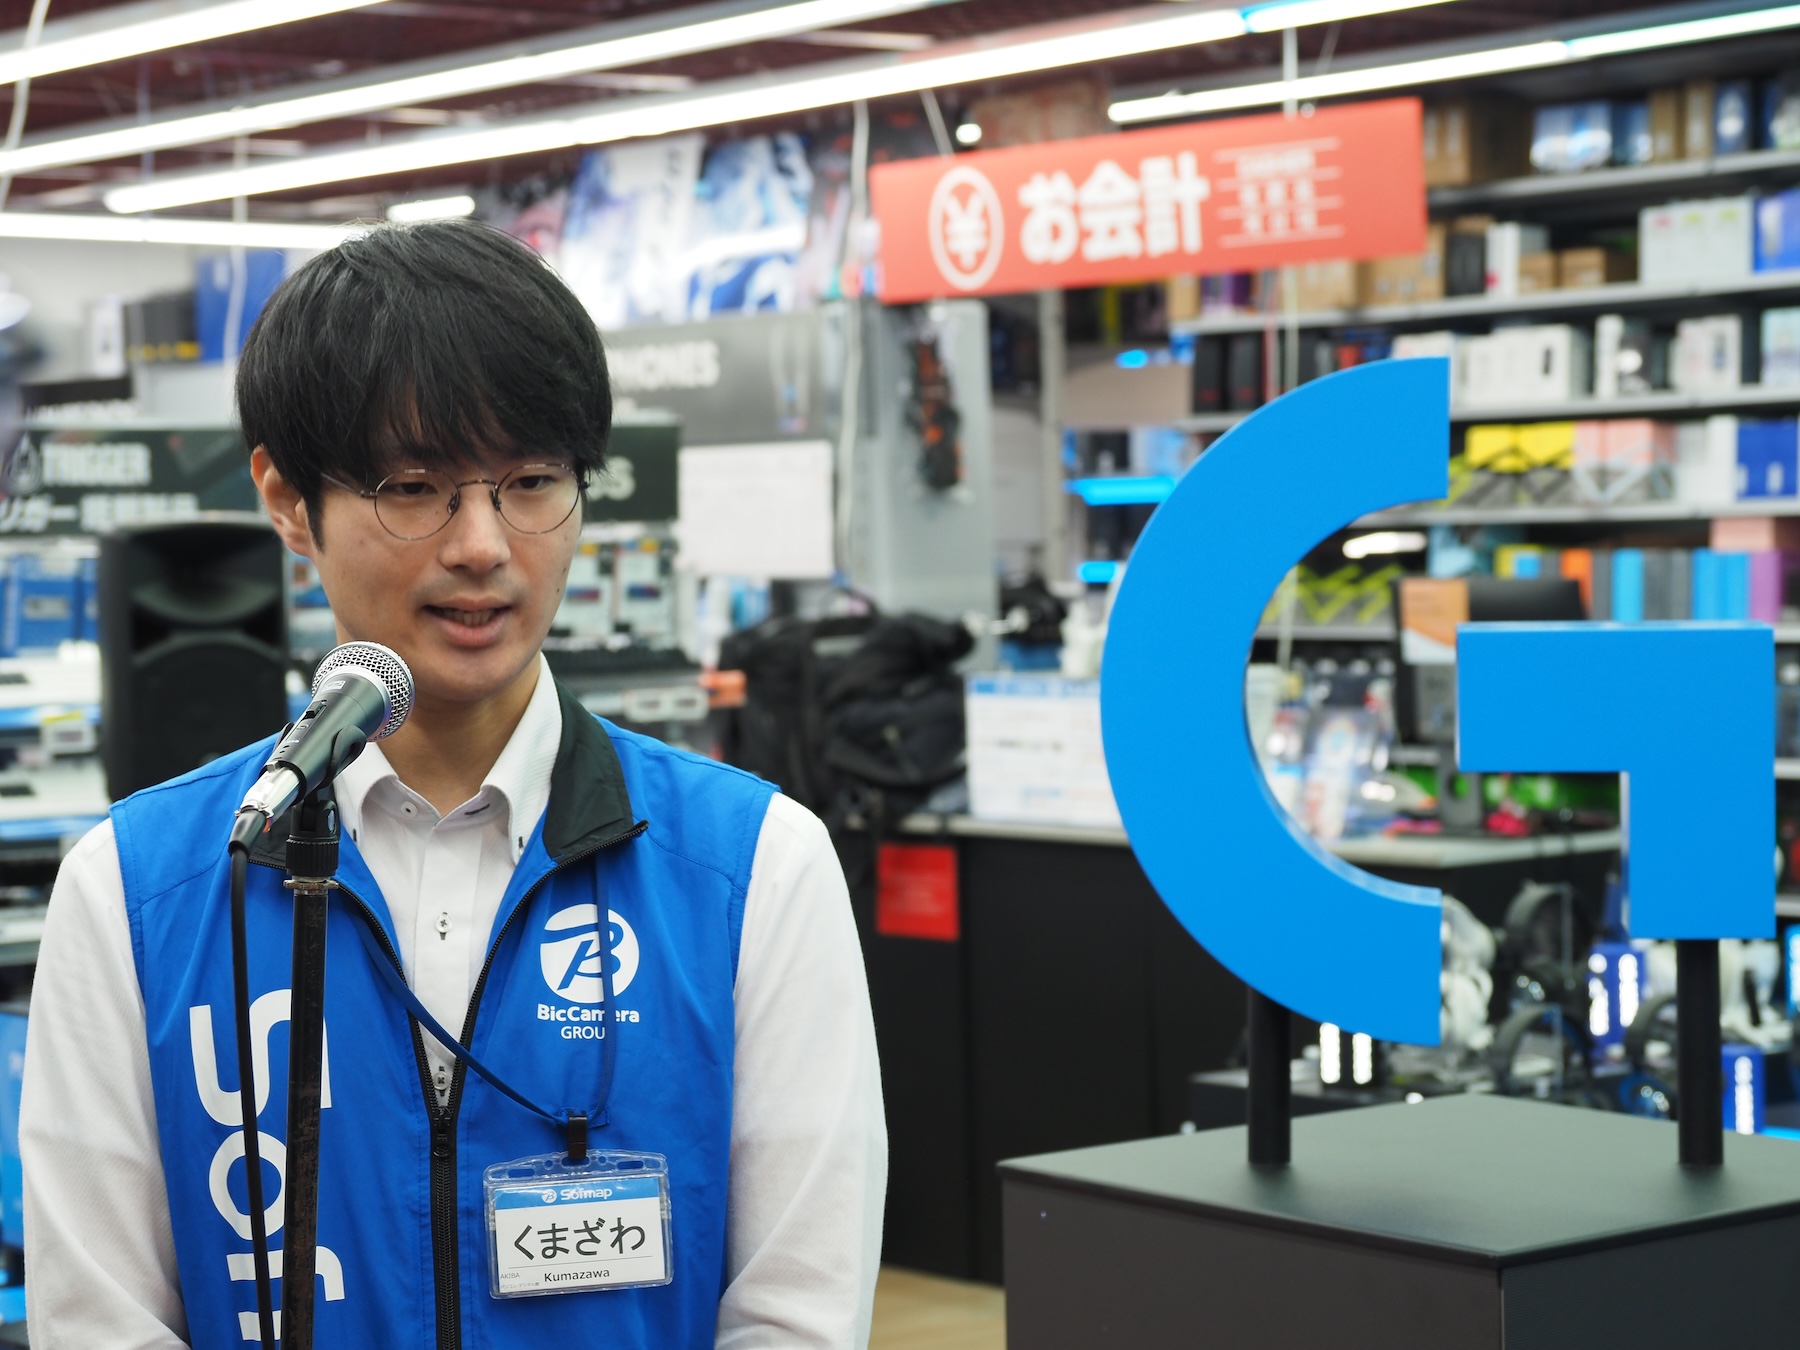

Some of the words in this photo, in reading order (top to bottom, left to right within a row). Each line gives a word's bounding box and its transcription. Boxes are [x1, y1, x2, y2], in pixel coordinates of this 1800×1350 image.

[1018, 152, 1210, 264] お会計
[537, 1003, 640, 1023] BicCamra
[560, 1025, 606, 1040] GROU
[560, 1187, 613, 1201] Sofmap
[514, 1217, 646, 1261] くまざわ
[544, 1268, 610, 1283] Kumazawa
